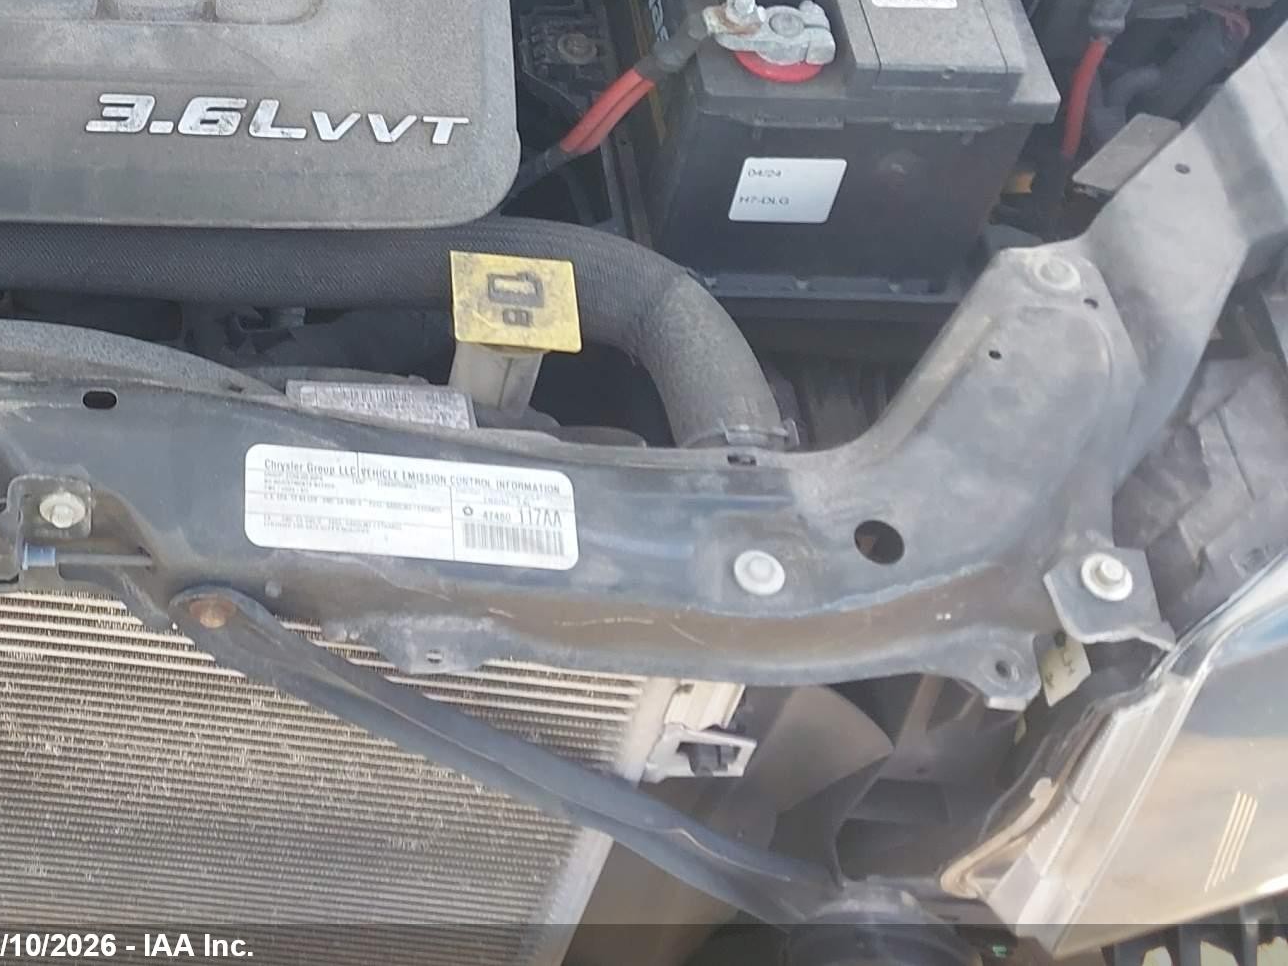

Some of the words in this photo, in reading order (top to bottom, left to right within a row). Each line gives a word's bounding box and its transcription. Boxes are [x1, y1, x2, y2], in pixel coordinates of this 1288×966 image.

[85, 93, 307, 139] 3.6L
[312, 111, 470, 145] VVT
[264, 458, 303, 474] Chrysler
[306, 463, 336, 476] Group
[339, 465, 356, 476] LLC
[361, 467, 397, 480] VEHICLE
[402, 471, 447, 484] EMISSION
[450, 475, 491, 487] CONTROL
[495, 480, 560, 494] INFORMATION
